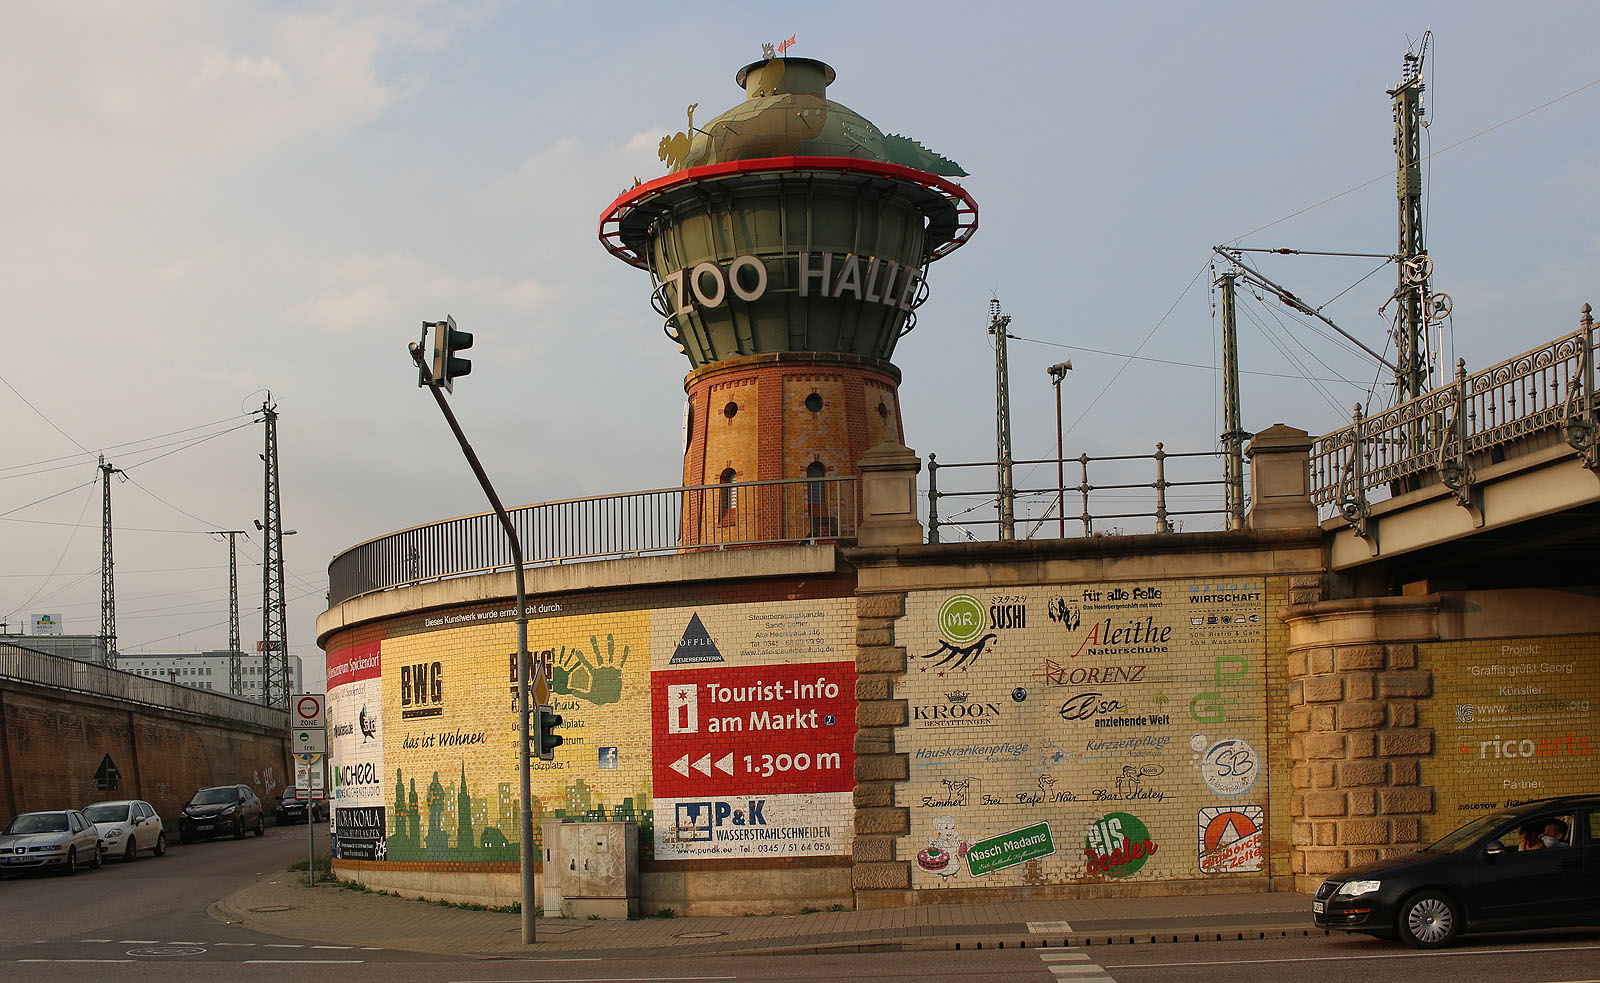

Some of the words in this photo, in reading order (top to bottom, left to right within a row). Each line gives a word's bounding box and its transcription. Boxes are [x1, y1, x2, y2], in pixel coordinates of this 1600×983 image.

[666, 255, 768, 316] ZOO
[798, 251, 924, 312] HALLE
[1082, 589, 1103, 601] für
[1106, 588, 1129, 600] alle
[1132, 587, 1163, 600] Felle
[1189, 592, 1261, 603] WIRTSCHAFT
[425, 617, 444, 627] Dieses
[444, 611, 477, 624] Kunstwerk
[477, 609, 498, 620] wurde
[499, 604, 537, 618] ermöcht
[538, 602, 563, 614] durch:
[948, 612, 977, 627] MR.
[990, 604, 1026, 629] SUSHI
[1071, 616, 1172, 658] Aleithe
[671, 655, 723, 664] STEUERBERATERIN
[1088, 645, 1168, 656] Naturschuhe
[1501, 645, 1542, 657] Projekt:
[1057, 665, 1147, 685] LORENZ
[1508, 663, 1537, 677] grüßt
[400, 661, 443, 706] BWG
[706, 677, 839, 703] Tourist-Info
[1499, 684, 1546, 696] Künstler:
[913, 703, 1002, 720] KROON
[1059, 692, 1128, 720] Elisa
[707, 716, 743, 733] am
[748, 708, 819, 731] Markt
[924, 719, 992, 727] BESTATTUNGEN
[1094, 715, 1147, 728] anziehende
[1149, 714, 1170, 725] Welt
[402, 735, 420, 750] das
[421, 733, 435, 748] ist
[438, 728, 488, 747] Wohnen
[1086, 735, 1171, 751] Kurzzeitpflege
[1480, 733, 1592, 760] ricoarts
[916, 742, 1029, 759] Hauskrankenpflege
[743, 752, 811, 778] 1.300
[816, 752, 841, 770] m
[1215, 750, 1254, 776] SB
[1503, 779, 1545, 790] Partner:
[921, 796, 962, 808] Zimmer
[981, 794, 1001, 805] Frei
[1055, 791, 1077, 802] Noir
[1092, 789, 1119, 801] Bar
[353, 809, 380, 827] KOALA
[714, 800, 768, 826] P&K
[716, 826, 831, 841] WASSERSTRAHLSCHNEIDEN
[677, 846, 733, 856] www.pundk.eu
[757, 844, 779, 853] 0345
[788, 844, 798, 852] 51
[814, 842, 831, 851] 056
[970, 844, 1002, 863] Nasch
[1003, 832, 1047, 852] Madame
